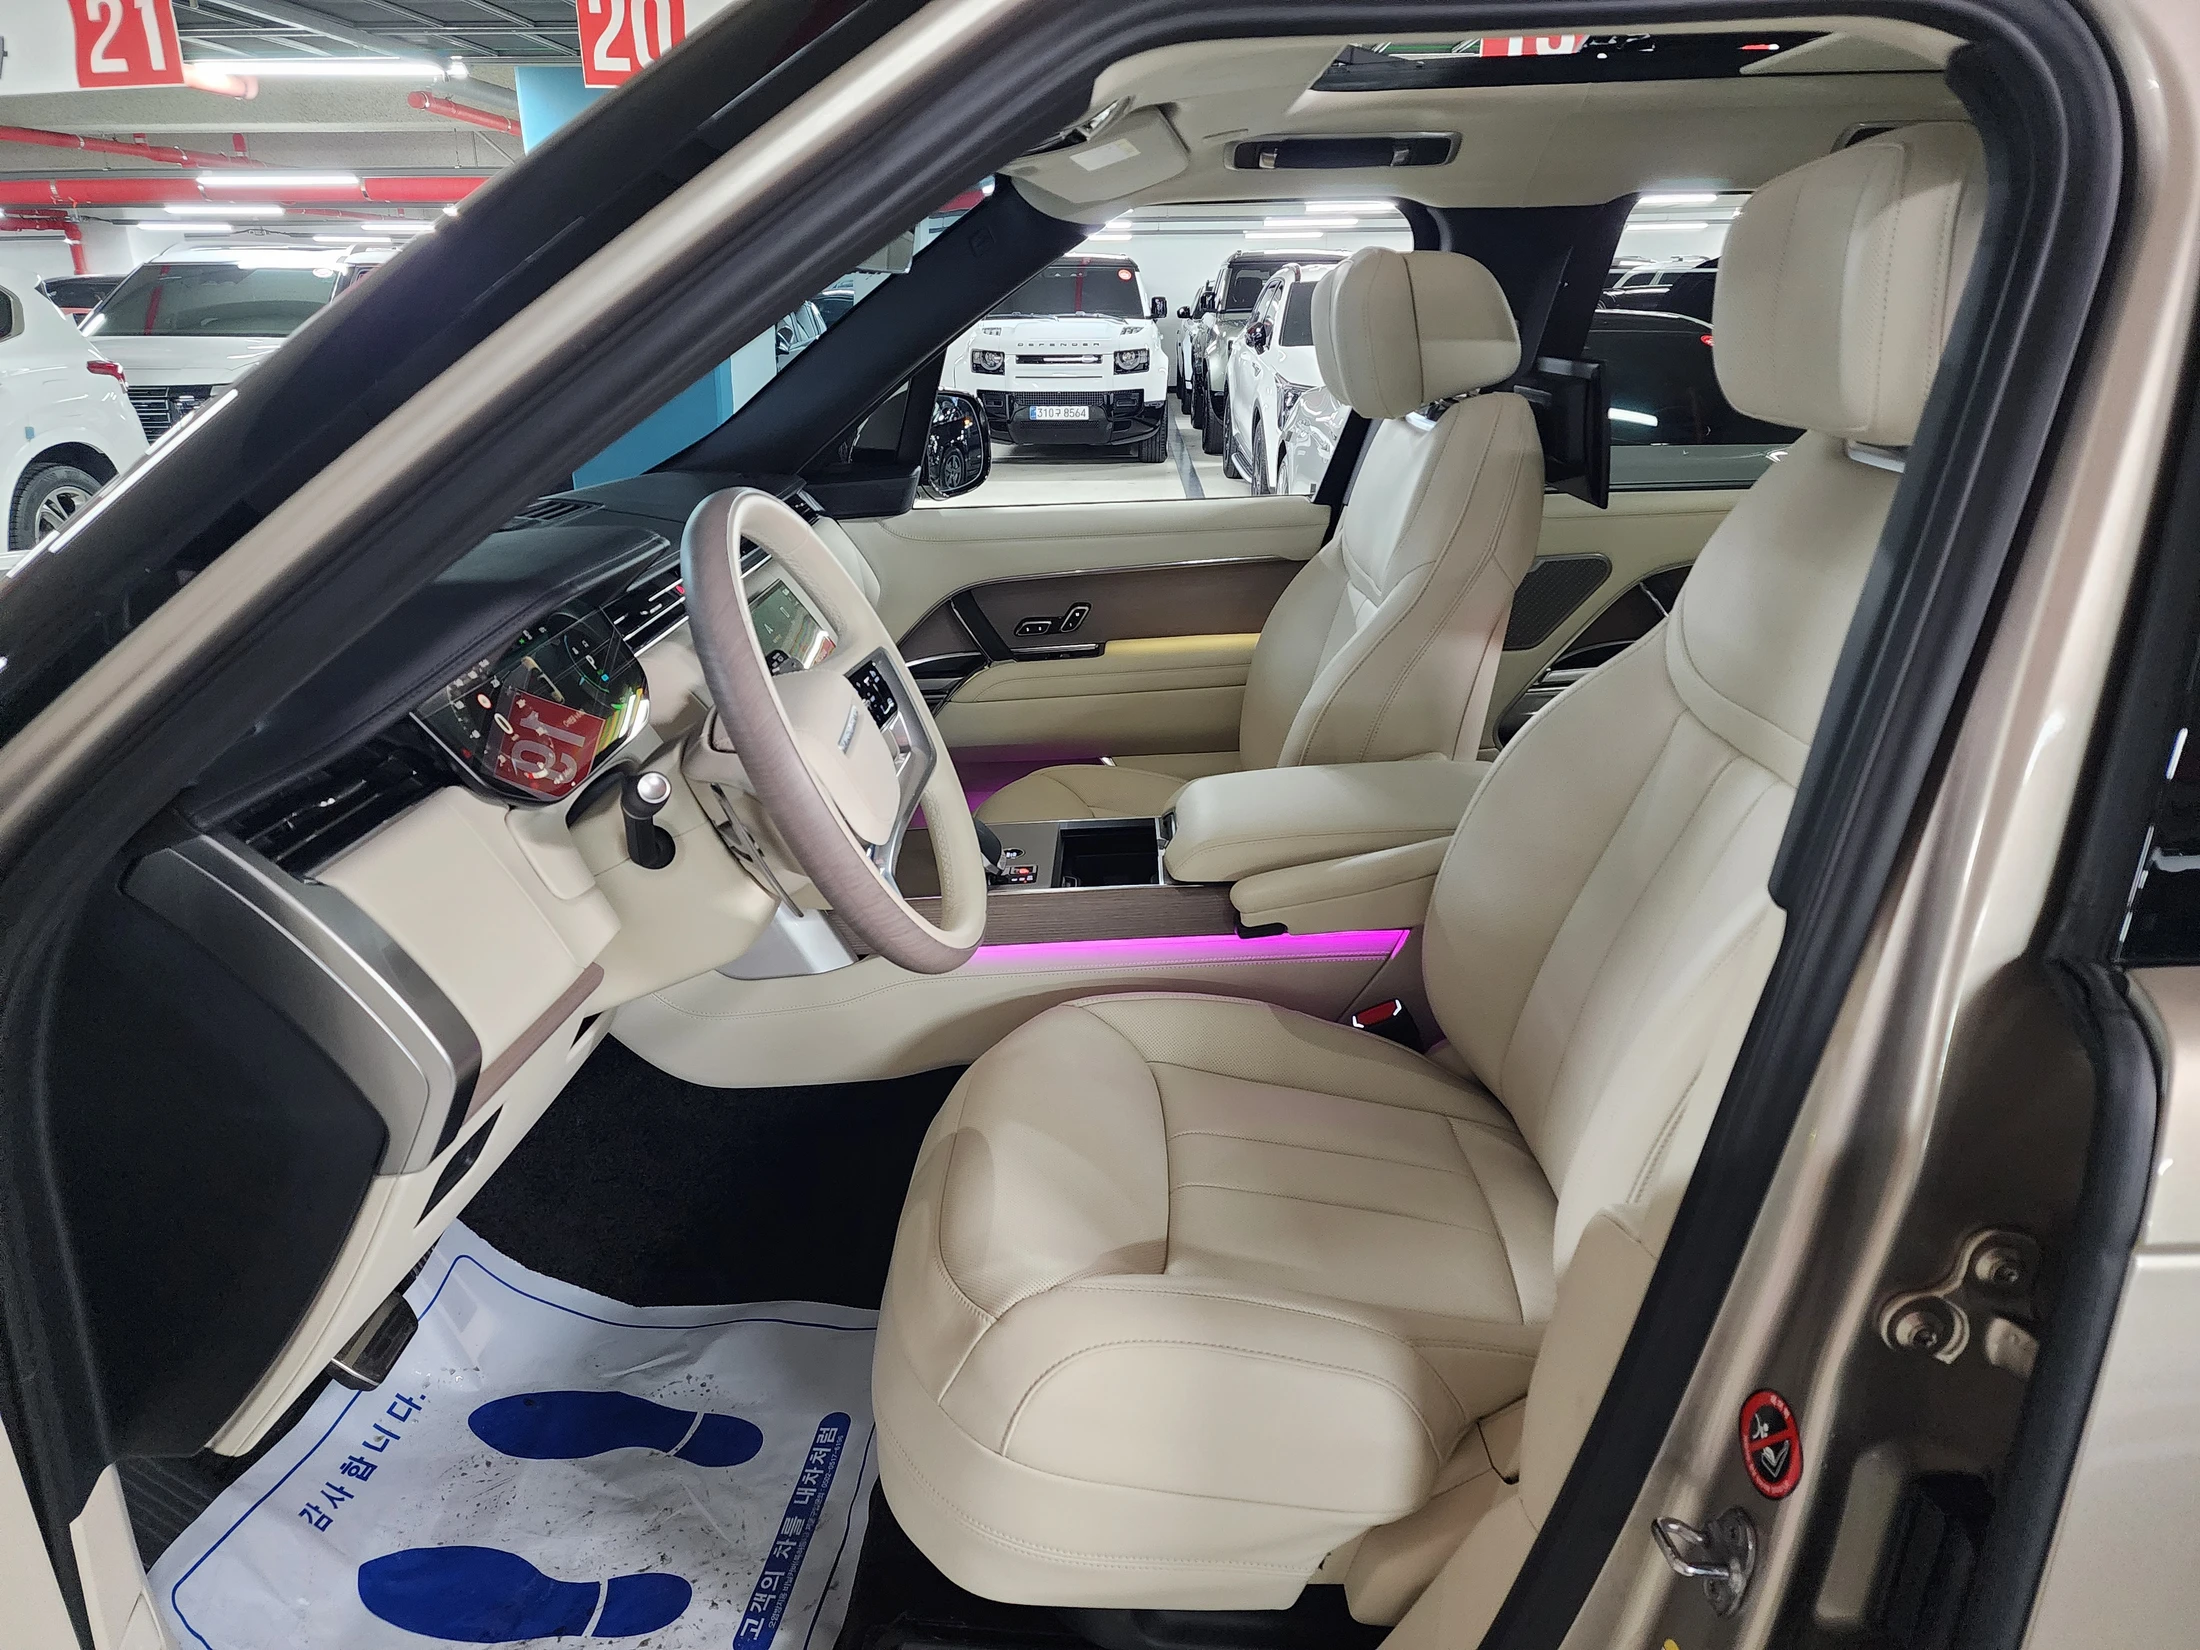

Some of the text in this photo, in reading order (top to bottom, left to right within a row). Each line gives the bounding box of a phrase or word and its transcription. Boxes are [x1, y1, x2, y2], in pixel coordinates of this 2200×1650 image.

[85, 0, 167, 73] 21
[588, 0, 672, 71] 20
[1063, 408, 1086, 418] 8564
[740, 1427, 838, 1641] 고객의 차를 내차처럼
